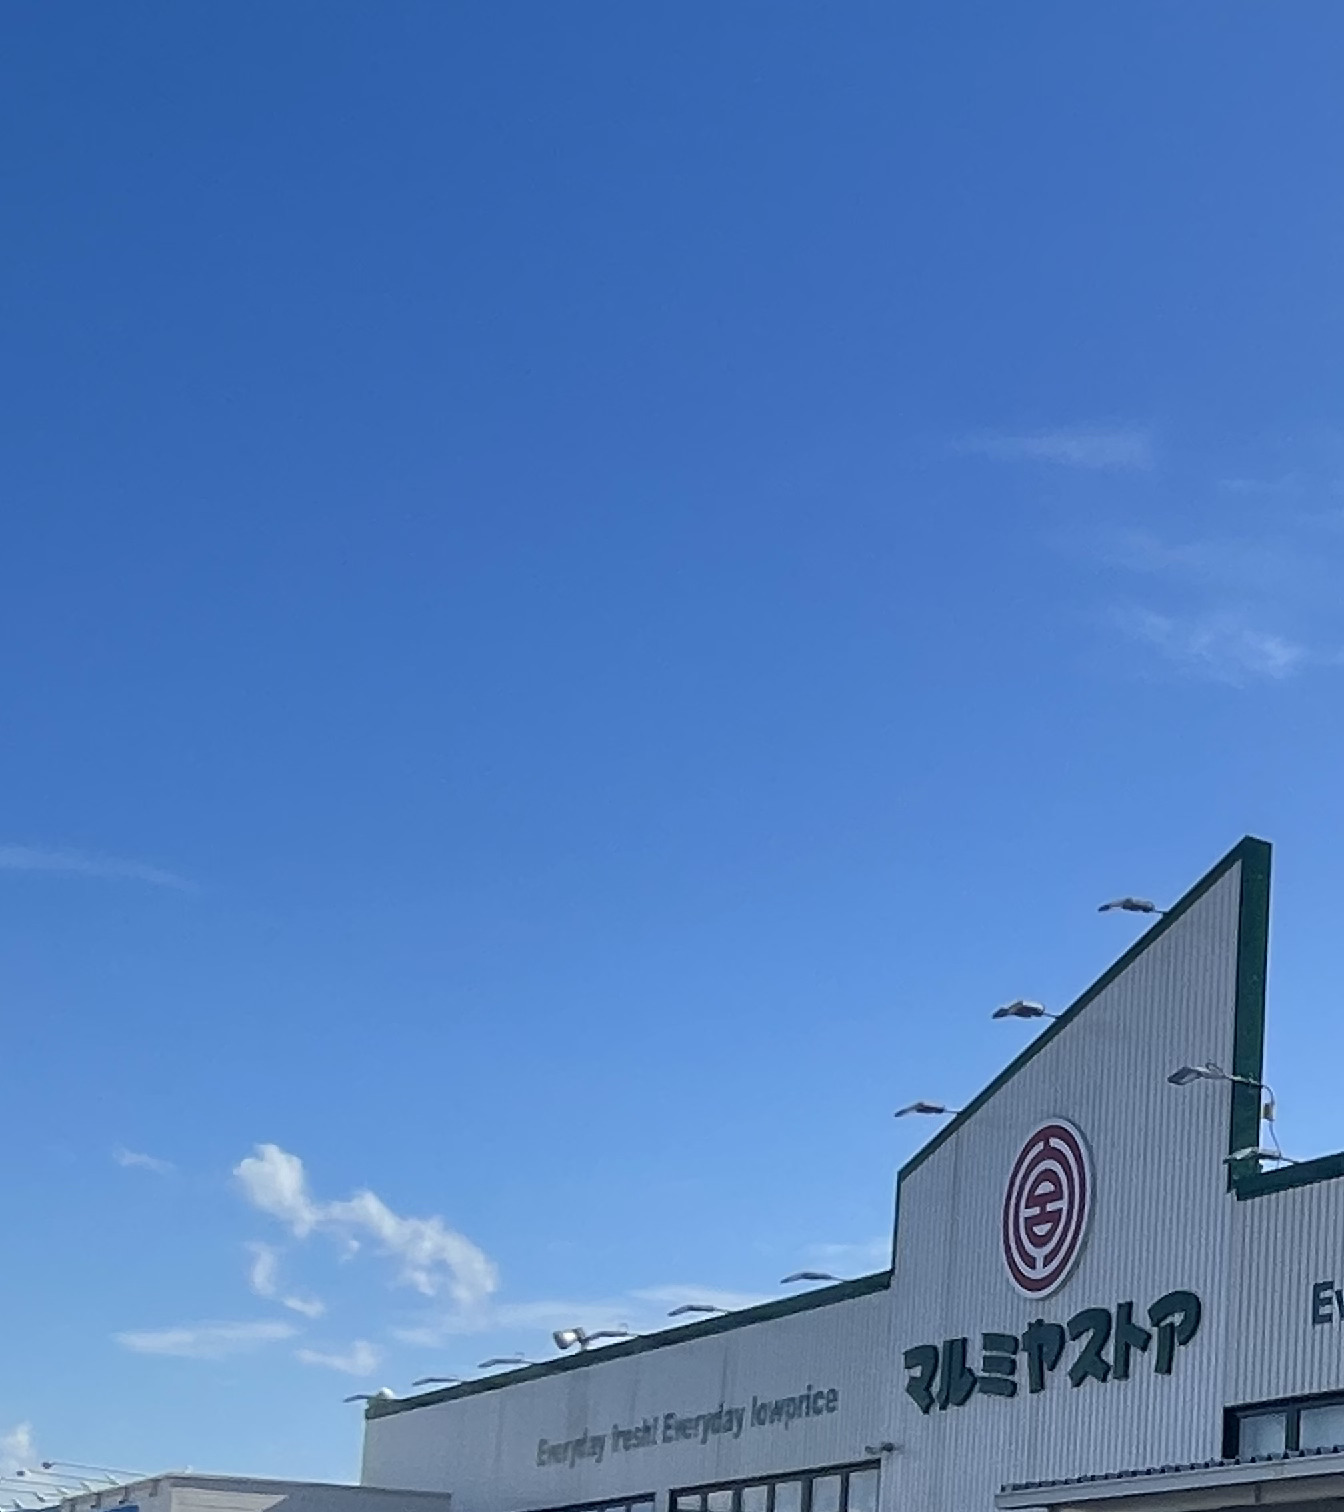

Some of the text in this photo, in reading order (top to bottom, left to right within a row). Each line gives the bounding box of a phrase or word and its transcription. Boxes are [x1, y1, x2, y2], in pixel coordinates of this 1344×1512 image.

[903, 1290, 1201, 1415] マルミヤストア
[536, 1426, 606, 1469] Everyday
[662, 1401, 745, 1445] Everyday
[750, 1384, 838, 1430] lowprice
